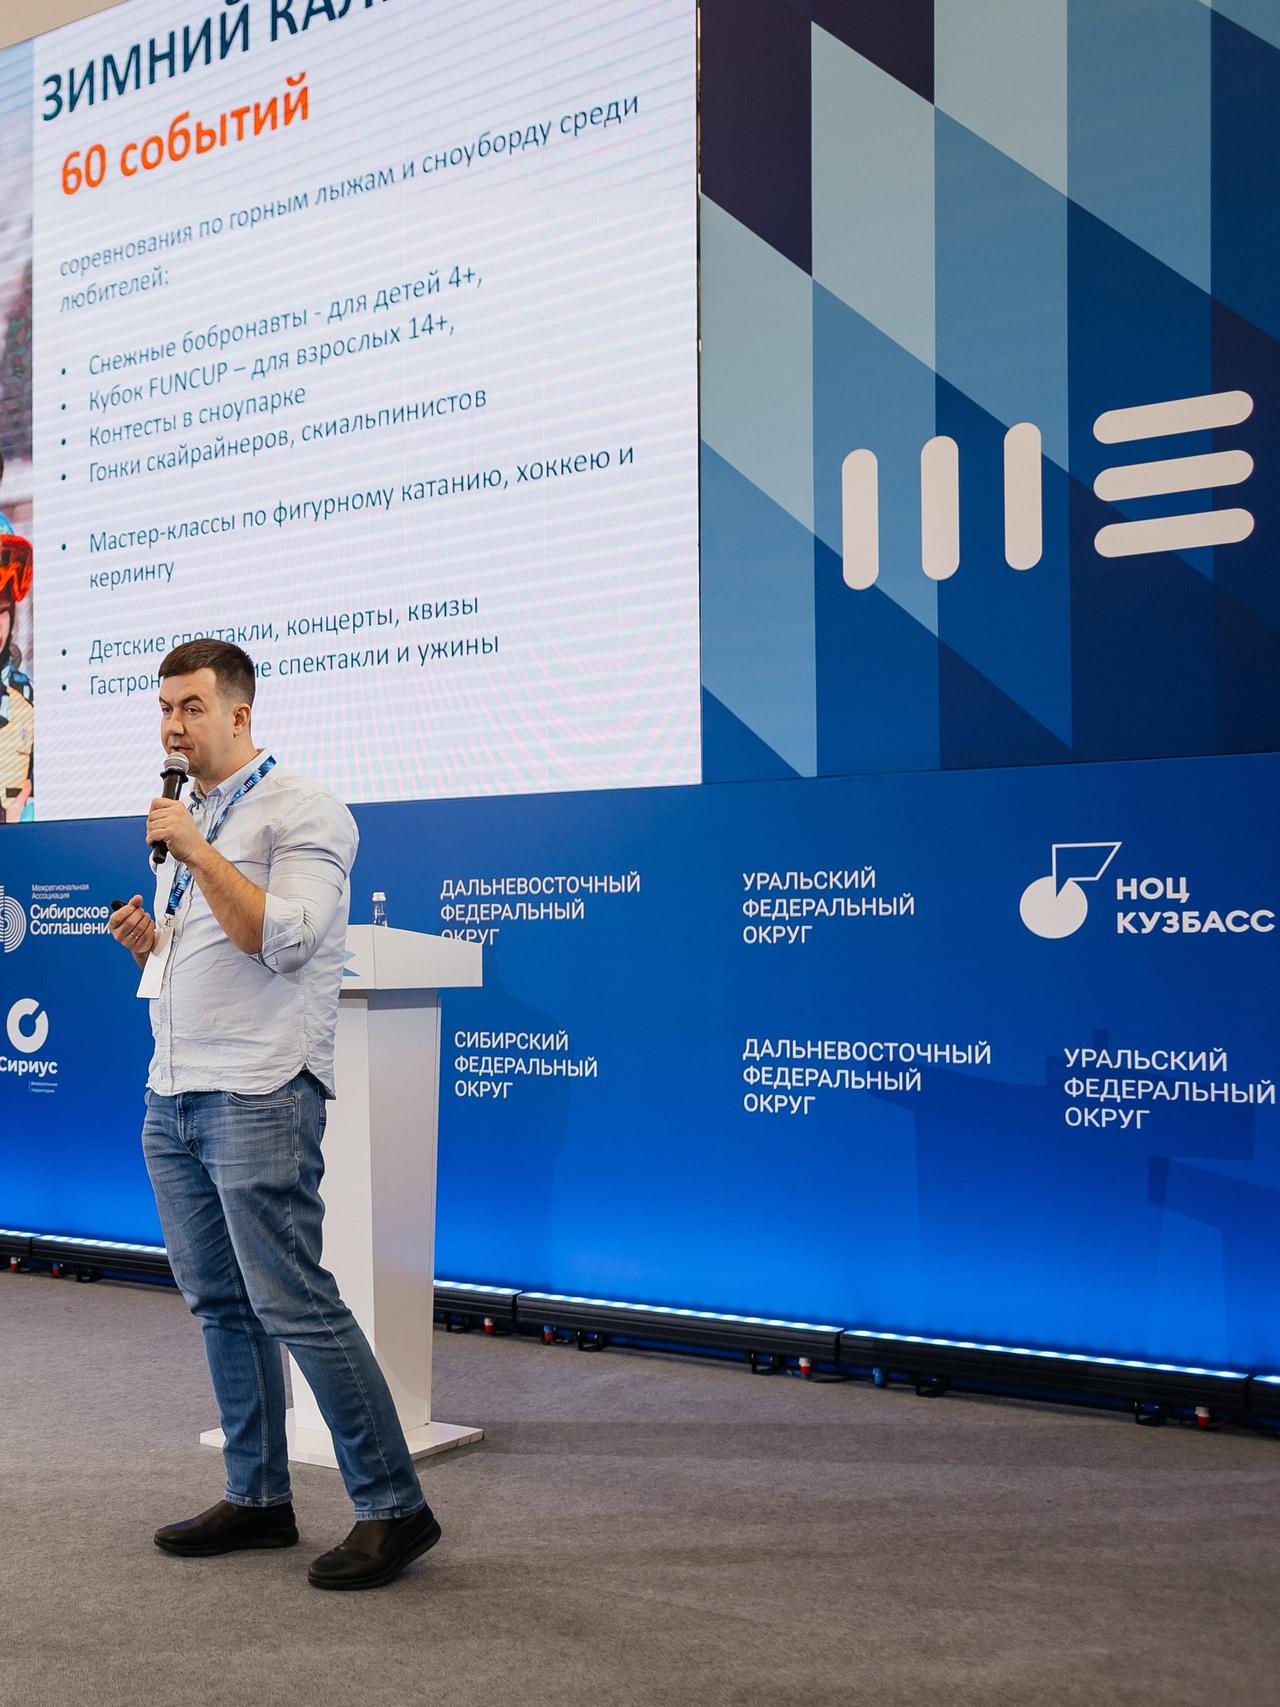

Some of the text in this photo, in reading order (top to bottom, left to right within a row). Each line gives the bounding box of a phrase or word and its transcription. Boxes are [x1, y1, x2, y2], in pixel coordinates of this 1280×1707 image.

[42, 0, 249, 121] ЗИМНИЙ
[62, 72, 308, 195] 60 событий
[60, 95, 638, 276] соревнования по горным лыжам и сноуборду среди
[59, 265, 170, 312] любителей:
[89, 341, 176, 376] Снежные
[182, 309, 307, 354] бобронавты
[327, 294, 367, 325] для
[373, 269, 440, 313] детей
[448, 266, 482, 289] 4+,
[89, 384, 143, 414] Кубок
[149, 362, 228, 398] FUNCUP
[251, 352, 289, 381] для
[297, 327, 401, 365] взрослых
[408, 313, 454, 340] 14+,
[89, 387, 306, 447] Контесты в сноупарке
[89, 389, 487, 483] Гонки скайрайнеров, скиальпинистов
[90, 446, 634, 553] Мастер-классы по фигурному катанию, хоккею и
[90, 561, 174, 591] керлингу
[88, 635, 165, 664] Детские
[287, 607, 400, 637] концерты,
[408, 597, 479, 622] квизы
[279, 645, 389, 677] спектакли
[397, 646, 410, 664] и
[418, 635, 499, 667] ужины
[440, 871, 641, 900] ДАЛЬНЕВОСТОЧНЫЙ
[742, 865, 876, 891] УРАЛЬСКИЙ
[1116, 876, 1190, 904] НОЦ
[30, 903, 109, 922] Сибирское
[440, 899, 585, 924] ФЕДЕРАЛЬНЫЙ
[742, 893, 915, 920] ФЕДЕРАЛЬНЫЙ
[30, 920, 111, 935] Соглашени
[742, 924, 813, 945] ОКРУГ
[1116, 909, 1276, 935] КУЗБАСС
[454, 1030, 569, 1051] СИБИРСКИЙ
[742, 1038, 992, 1065] ДАЛЬНЕВОСТОЧНЫЙ
[454, 1055, 598, 1079] ФЕДЕРАЛЬНЫЙ
[1064, 1046, 1228, 1072] УРАЛЬСКИЙ
[454, 1080, 513, 1099] ОКРУГ
[742, 1065, 922, 1092] ФЕДЕРАЛЬНЫЙ
[1064, 1076, 1276, 1105] ФЕДЕРАЛЬНЫЙ
[743, 1093, 816, 1115] ОКРУГ
[1064, 1106, 1150, 1130] ОКРУГ
